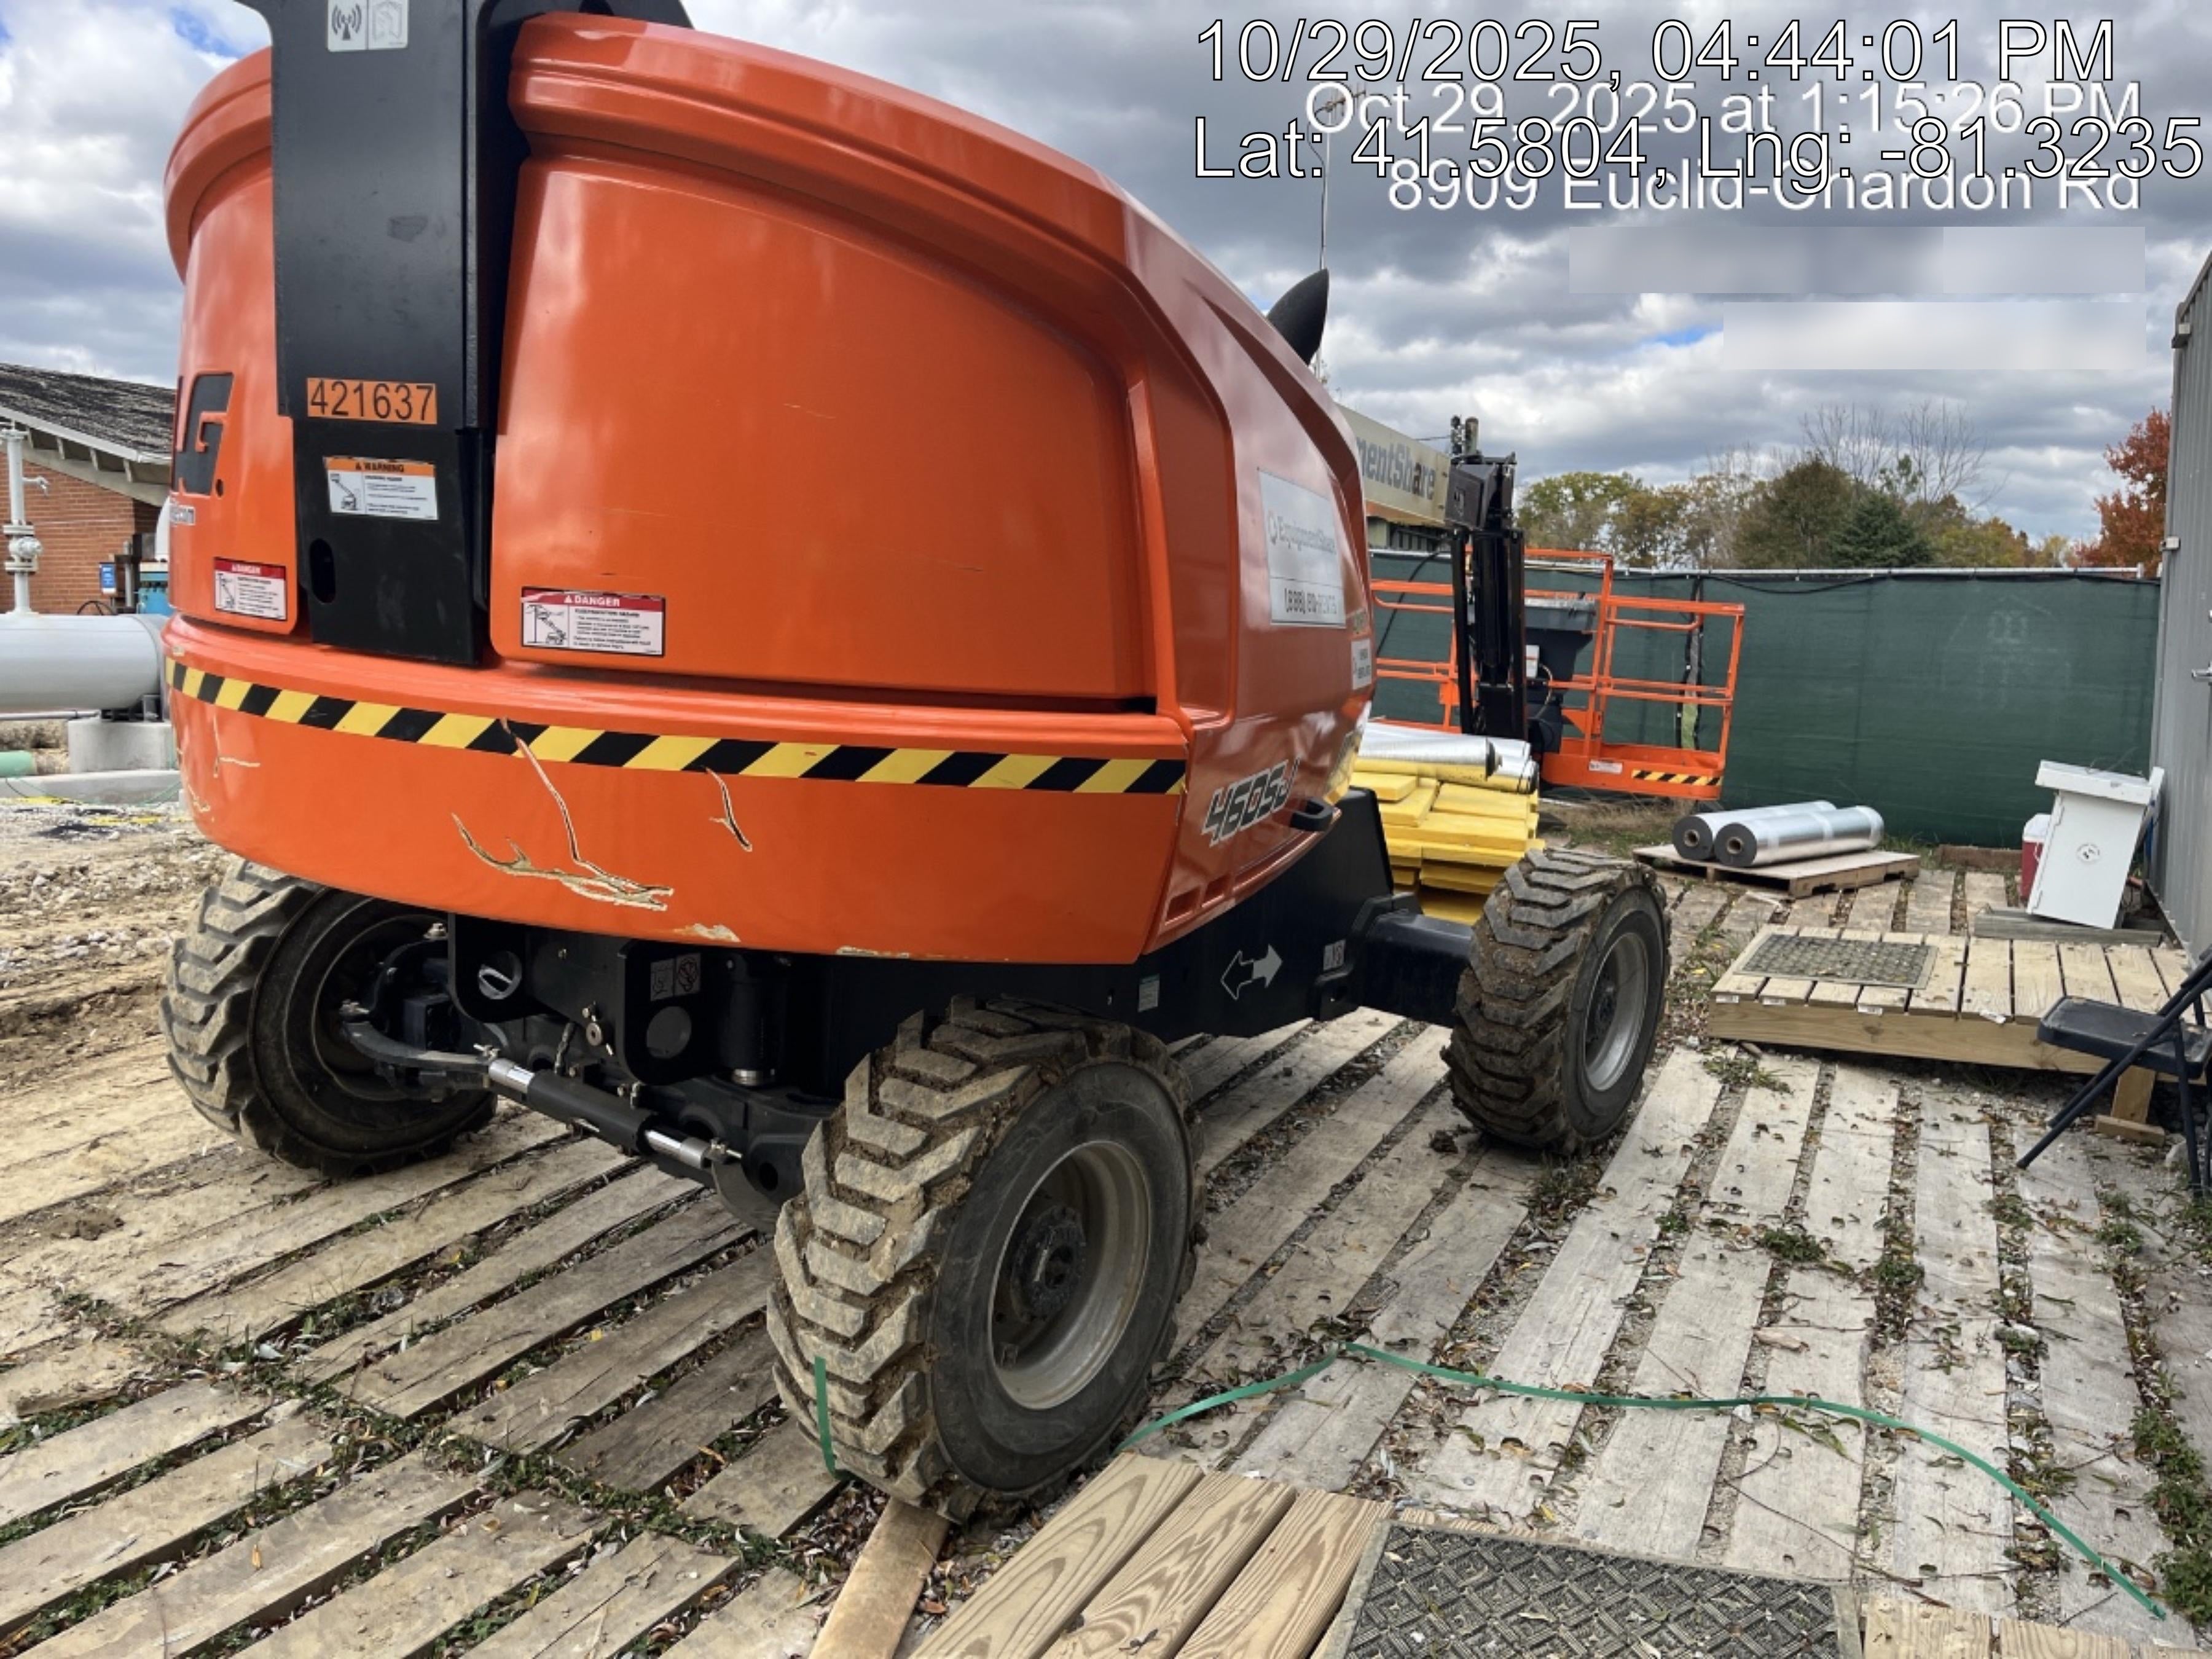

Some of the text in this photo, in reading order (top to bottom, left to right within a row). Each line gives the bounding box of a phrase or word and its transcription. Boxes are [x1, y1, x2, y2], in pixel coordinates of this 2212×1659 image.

[311, 380, 434, 421] 421637
[364, 462, 405, 473] WARNING
[574, 595, 621, 607] DANGER
